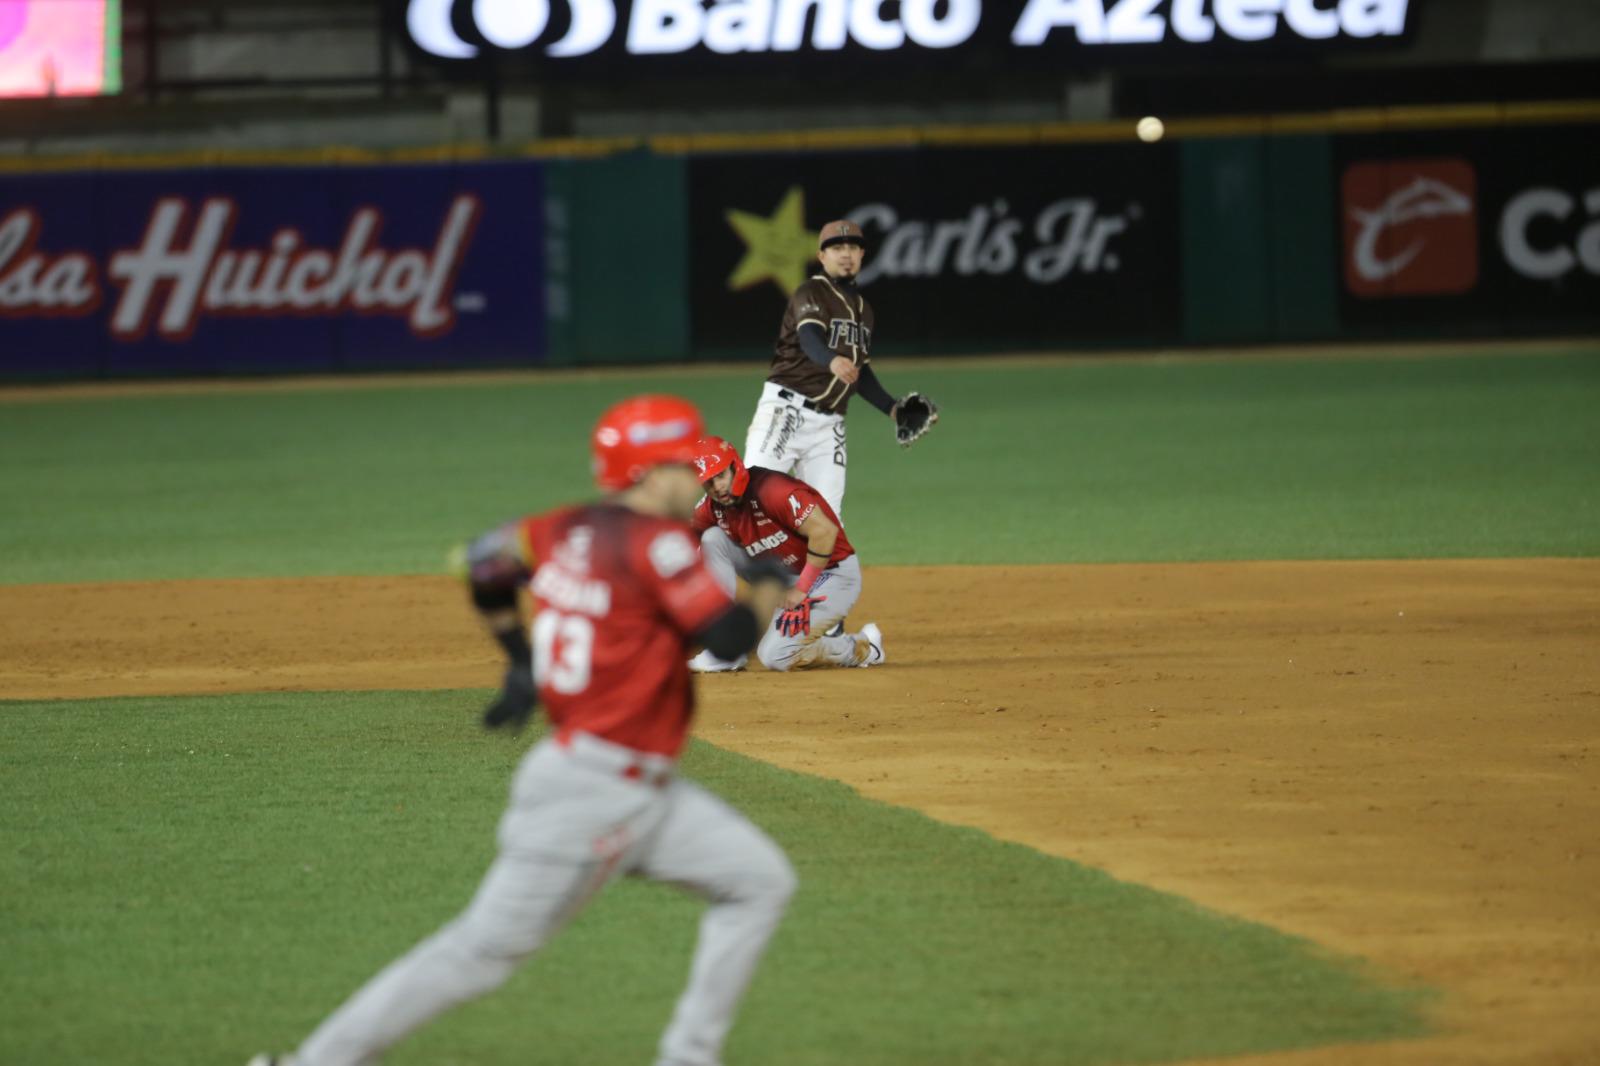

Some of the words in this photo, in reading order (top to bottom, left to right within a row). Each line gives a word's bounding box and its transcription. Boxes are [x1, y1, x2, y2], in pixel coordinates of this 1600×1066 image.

[625, 0, 982, 54] Banco
[1011, 0, 1407, 46] Azteca
[108, 196, 479, 337] Huichol
[847, 199, 1023, 287] Carl's
[1023, 198, 1127, 284] Jr.
